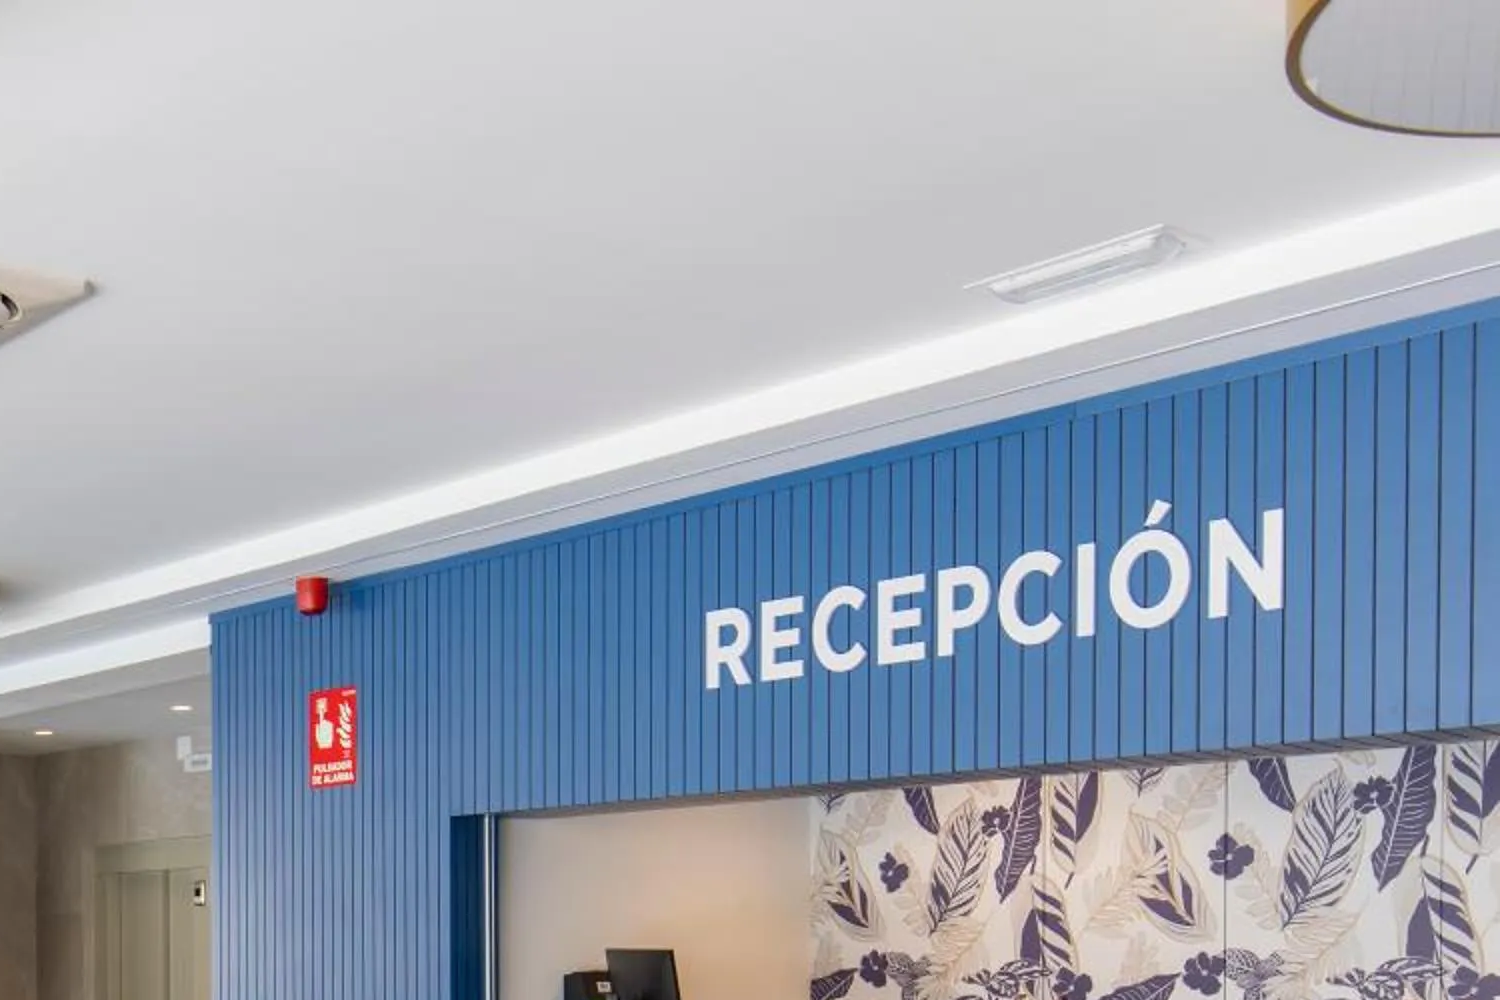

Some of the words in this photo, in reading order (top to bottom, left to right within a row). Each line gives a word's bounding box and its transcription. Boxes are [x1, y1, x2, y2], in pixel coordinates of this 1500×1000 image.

[705, 499, 1285, 689] RECEPCIÓN
[313, 760, 353, 775] PULSADOR
[311, 775, 322, 785] DE
[323, 771, 355, 784] ALARMA
